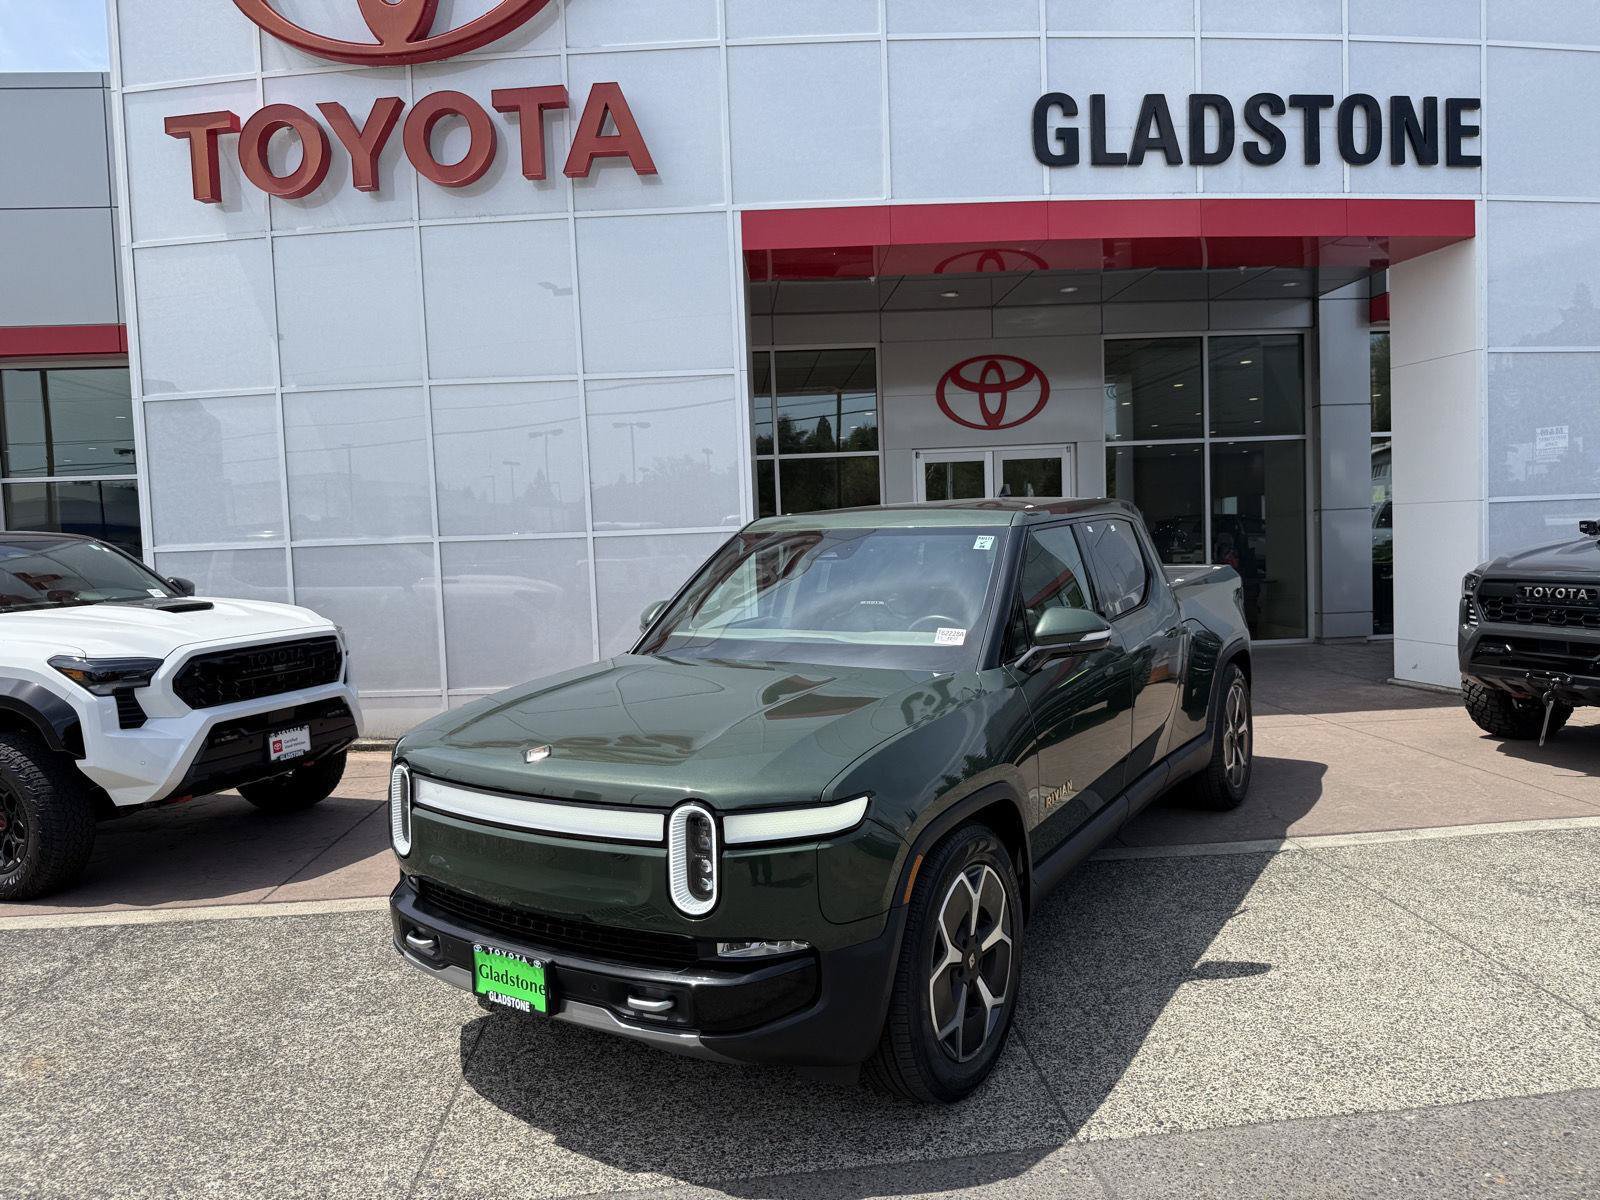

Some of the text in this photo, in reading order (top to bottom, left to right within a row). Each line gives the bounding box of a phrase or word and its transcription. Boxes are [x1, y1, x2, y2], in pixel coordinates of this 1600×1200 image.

[164, 82, 658, 204] TOYOTA
[1031, 92, 1482, 168] GLADSTONE
[1524, 586, 1588, 600] TOYOTA
[248, 647, 304, 667] TOYOTA
[1045, 779, 1073, 809] RIVIAN
[488, 947, 528, 964] TOYOTA
[479, 963, 546, 996] Gladstone
[488, 990, 531, 1013] GLADSTONE
